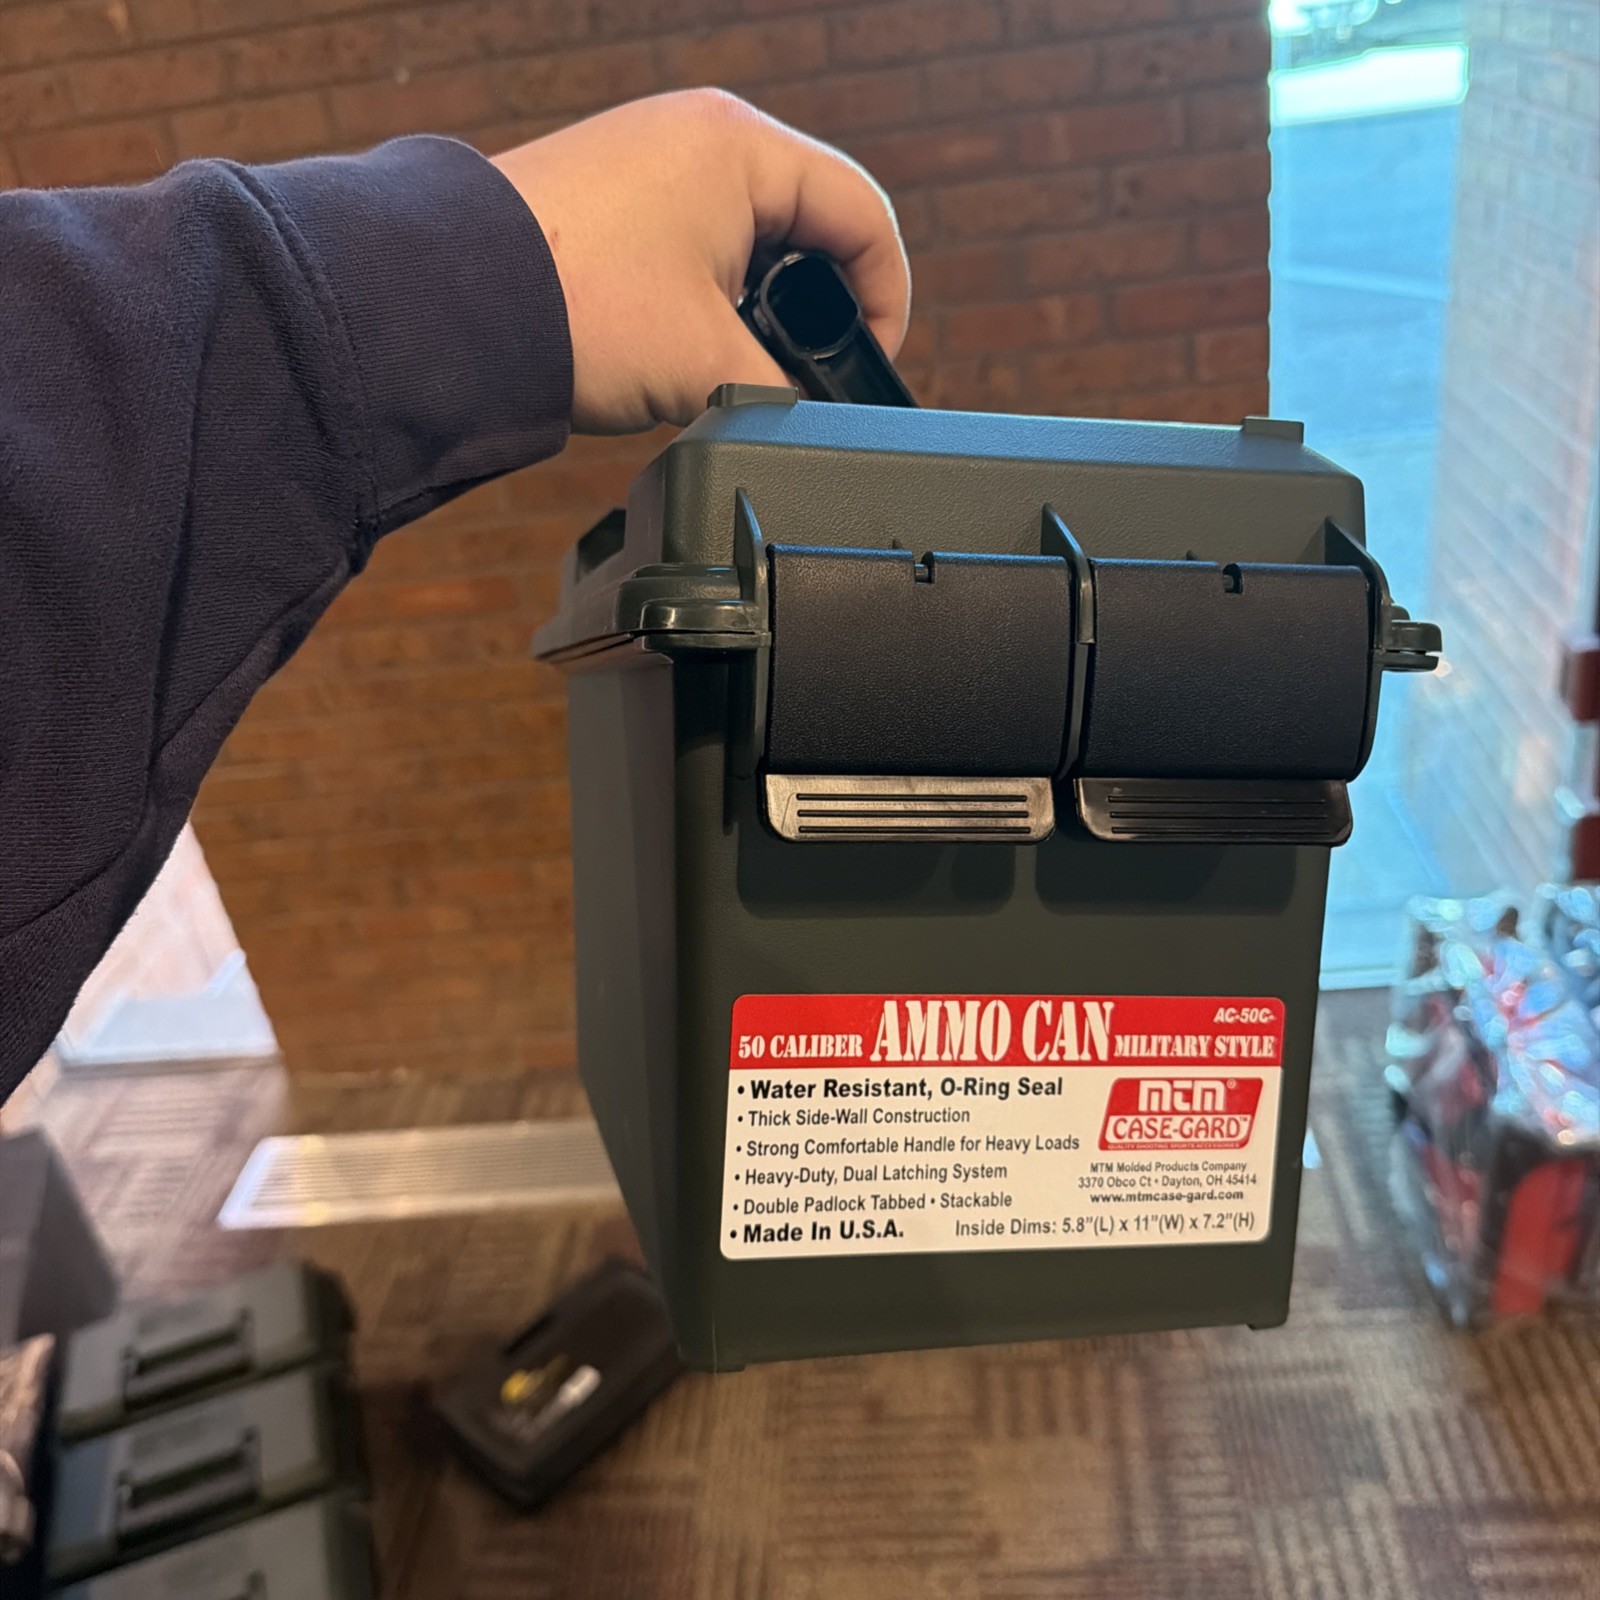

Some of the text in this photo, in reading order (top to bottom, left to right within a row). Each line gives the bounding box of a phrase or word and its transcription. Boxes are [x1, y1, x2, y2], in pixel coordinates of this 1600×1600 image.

[738, 999, 1275, 1062] 50 CALIBER AMMO CAN MILITARY STYLE
[751, 1077, 1063, 1100] Water Resistant, O-Ring Seal
[749, 1107, 971, 1126] Thick Side-Wall Construction
[747, 1135, 1080, 1159] Strong Comfortable Handle for Heavy Loads
[745, 1163, 1007, 1188] Heavy-Duty, Dual Latching System
[1090, 1161, 1247, 1172] MTM Molded Products Company
[1078, 1174, 1257, 1188] 3370 Obco Ct Dayton, OH 45414
[744, 1191, 1012, 1215] Double Padlock Tabbed Stackable
[1090, 1190, 1243, 1203] www.mtmcase-gard.com
[743, 1219, 904, 1243] Made In U.S.A.
[955, 1220, 1004, 1237] Inside
[1010, 1218, 1056, 1235] Dims:
[1120, 1217, 1128, 1231] x
[1189, 1215, 1198, 1229] x
